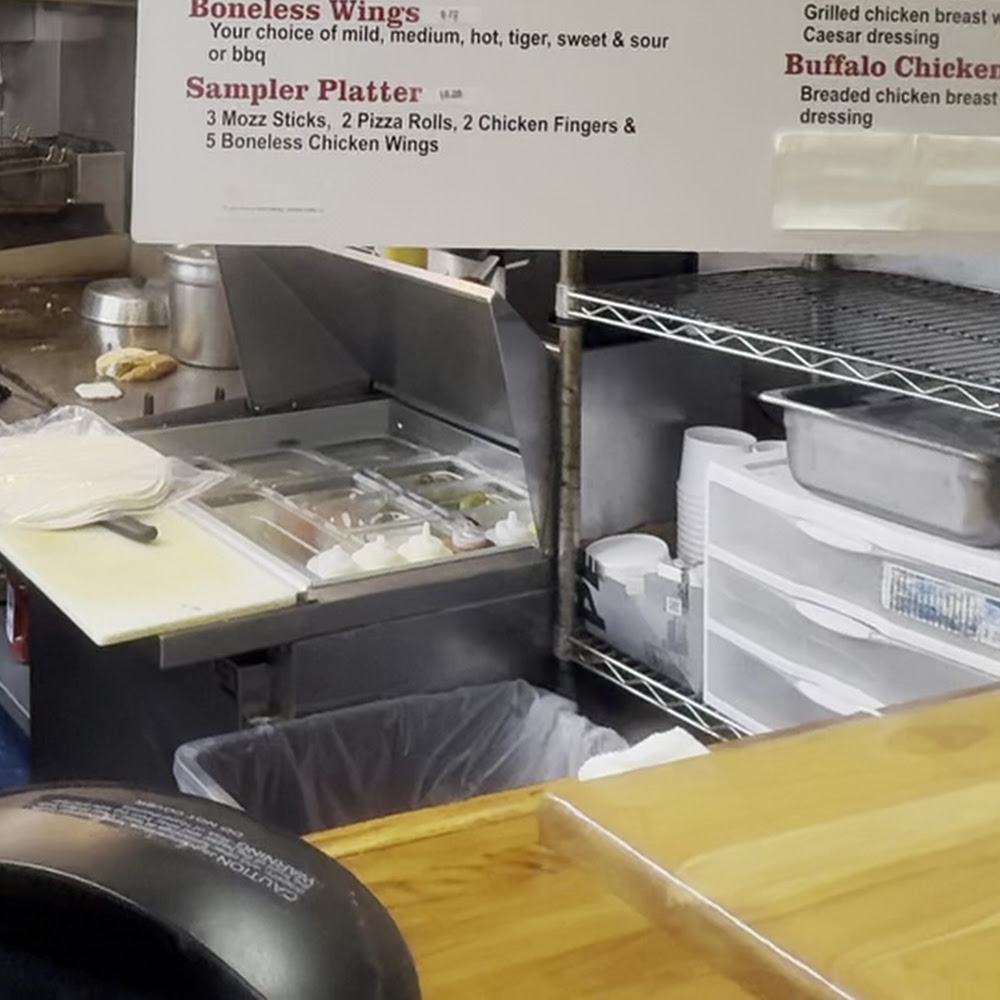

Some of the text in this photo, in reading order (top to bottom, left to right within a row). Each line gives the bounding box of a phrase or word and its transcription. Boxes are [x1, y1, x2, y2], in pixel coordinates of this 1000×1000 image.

[804, 3, 860, 22] Grilled
[864, 5, 930, 23] chicken
[934, 7, 987, 25] breast
[210, 21, 670, 50] Your choice mild, medium, hot, tiger, sweet sour
[803, 25, 940, 50] Caesar dressing
[232, 44, 266, 67] bbq
[784, 53, 887, 78] Buffalo
[186, 75, 310, 107] Sampler
[317, 79, 423, 103] Platter
[800, 85, 998, 106] Breaded chicken breast
[222, 109, 618, 138] Mozz Sticks, Pizza Rolls, Chicken Fingers
[799, 107, 873, 130] dressing
[221, 131, 439, 157] Boneless Chicken Wings
